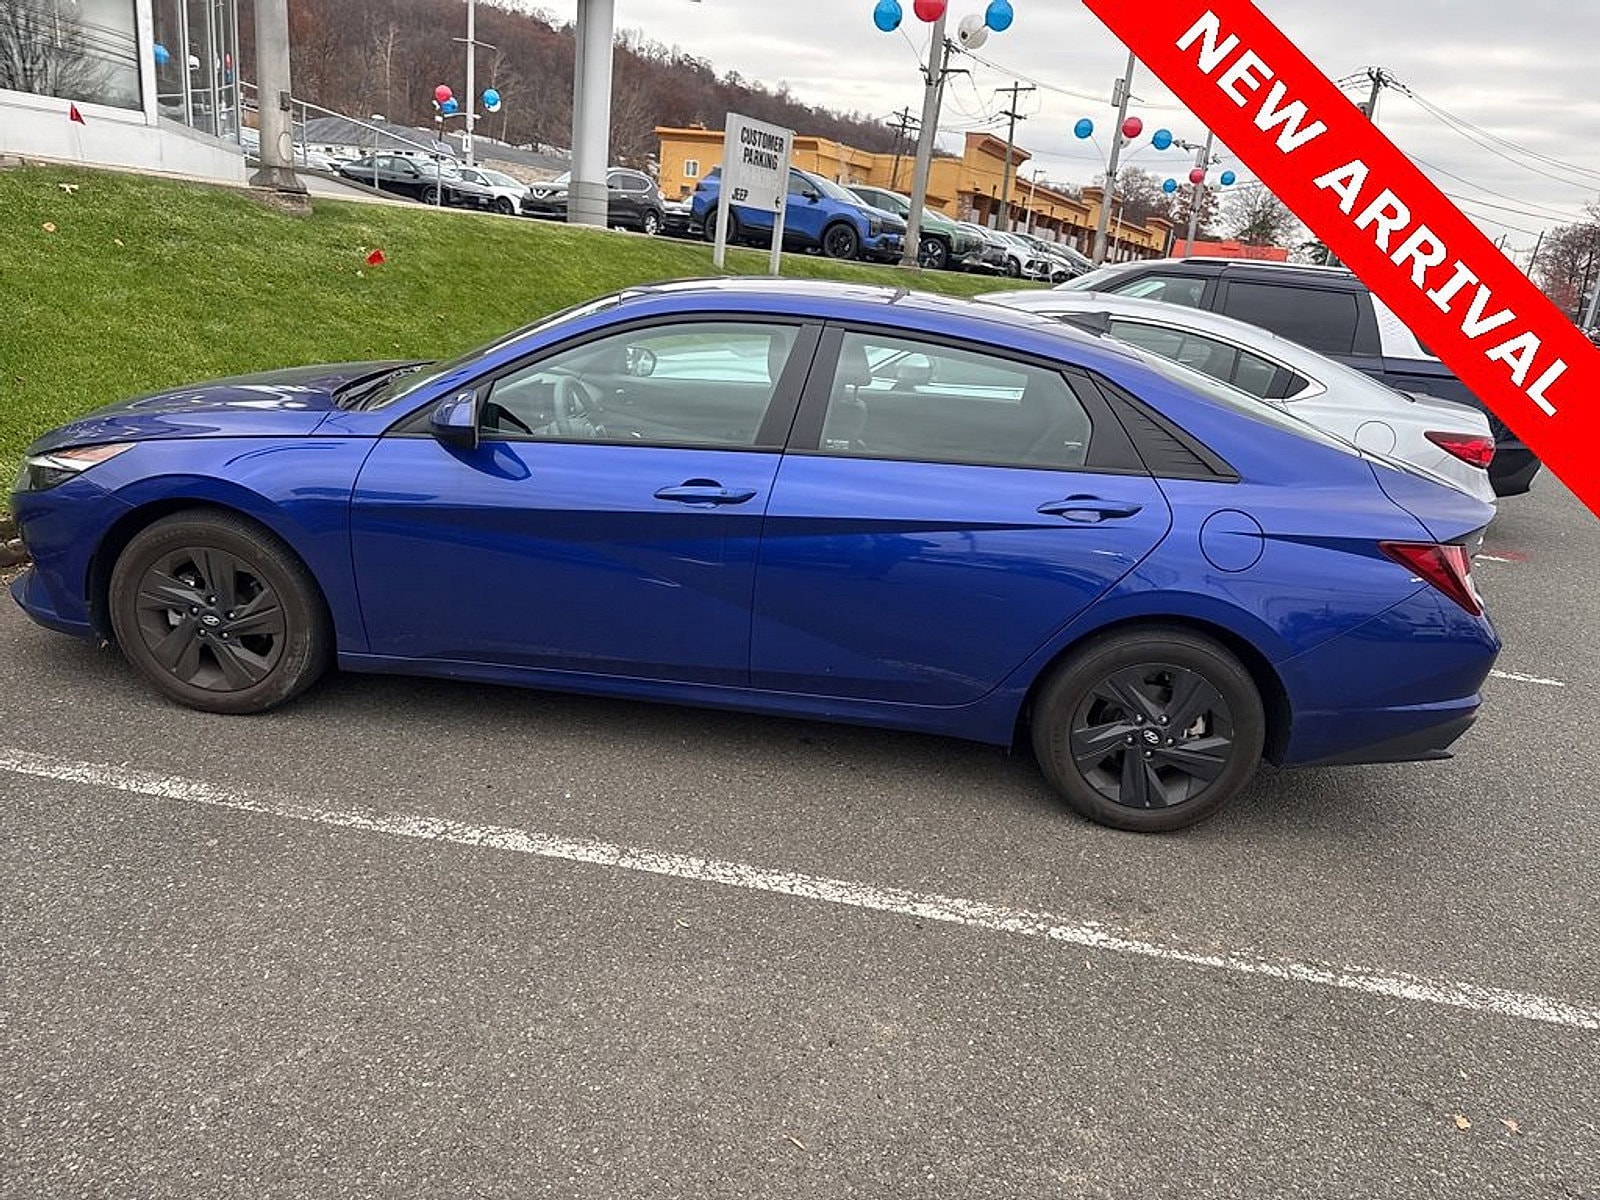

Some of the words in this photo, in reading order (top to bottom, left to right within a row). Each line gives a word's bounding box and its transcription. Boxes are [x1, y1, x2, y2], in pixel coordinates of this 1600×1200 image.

[741, 126, 784, 153] CUSTOMER
[743, 147, 778, 170] PARKING
[731, 187, 749, 201] JEEP
